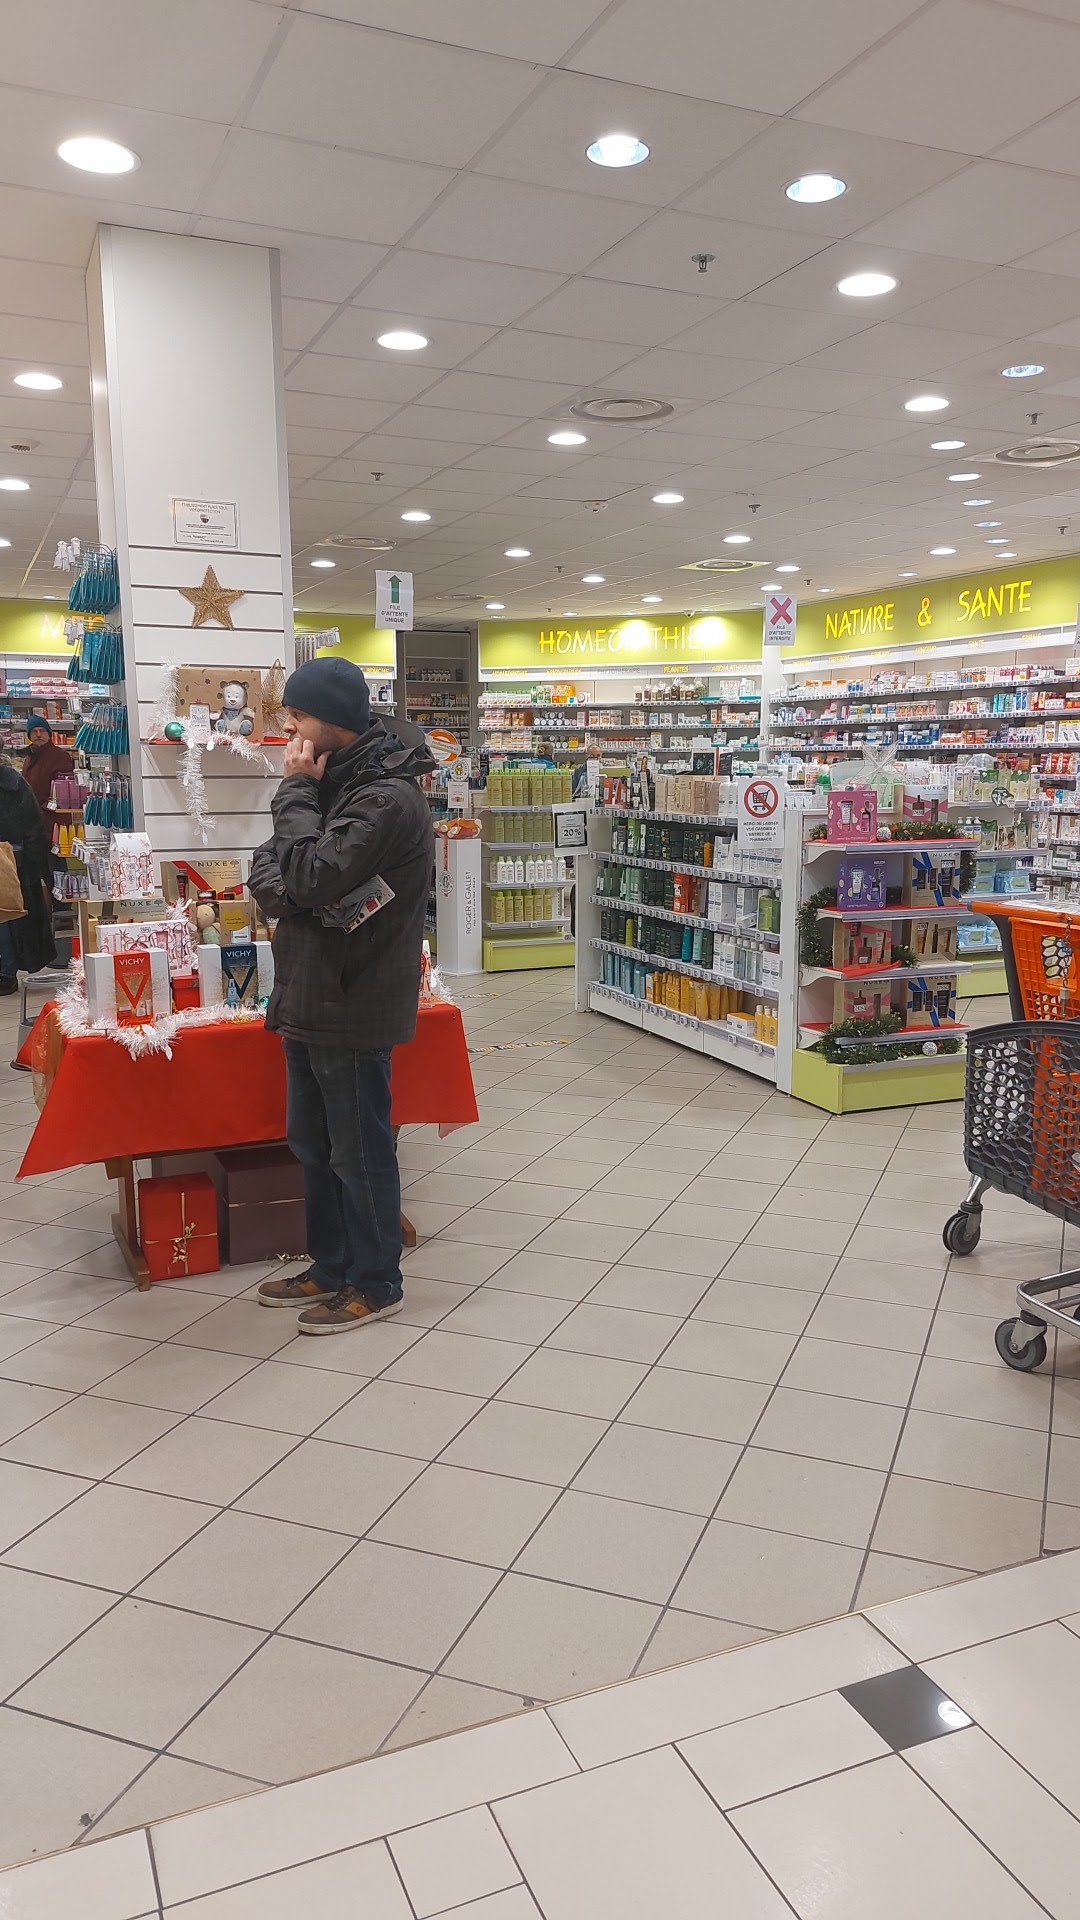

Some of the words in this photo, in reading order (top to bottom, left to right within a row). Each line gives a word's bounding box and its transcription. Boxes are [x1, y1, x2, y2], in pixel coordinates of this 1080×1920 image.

[381, 610, 409, 618] D'ATTENTE
[825, 603, 895, 640] NATURE
[917, 597, 933, 627] &
[956, 580, 1033, 622] SANTE
[539, 625, 703, 654] HOMEOTHIE
[967, 640, 985, 649] SANTE
[663, 665, 689, 674] PLANTES
[120, 900, 152, 908] NUXE
[225, 950, 252, 958] VICHY
[119, 957, 145, 966] VICHY
